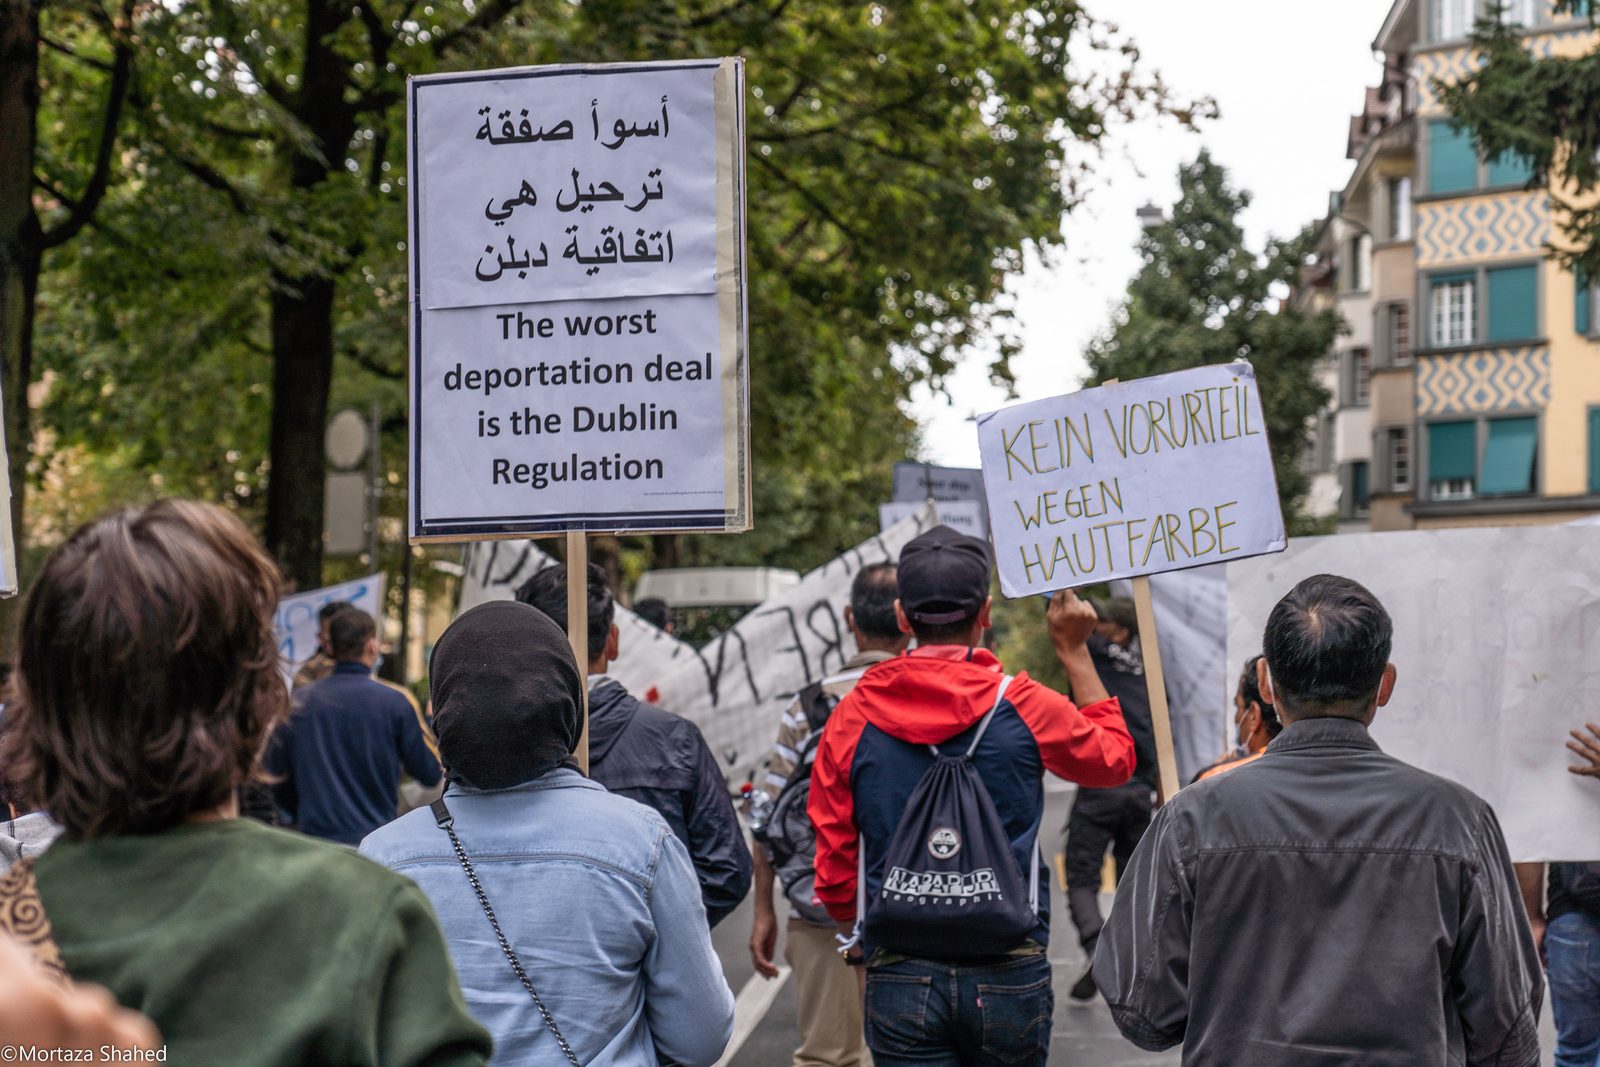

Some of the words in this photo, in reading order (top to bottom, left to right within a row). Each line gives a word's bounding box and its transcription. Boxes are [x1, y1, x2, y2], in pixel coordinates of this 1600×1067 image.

[475, 105, 574, 146] صفقة
[591, 94, 670, 150] أسوأ
[484, 179, 537, 227] هي
[555, 167, 664, 213] ترحيل
[474, 234, 549, 282] دبلن
[561, 224, 675, 277] اتفاقية
[496, 311, 555, 340] The
[563, 309, 657, 337] worst
[443, 356, 633, 396] deportation
[643, 352, 713, 382] deal
[477, 410, 501, 438] is
[509, 406, 562, 436] the
[572, 402, 678, 433] Dublin
[1001, 412, 1095, 481] KEIN
[1103, 377, 1261, 459] VORURTEIL
[491, 452, 665, 490] Regulation
[1013, 476, 1124, 531] WEGEN
[1019, 500, 1241, 584] HAUTFARBE
